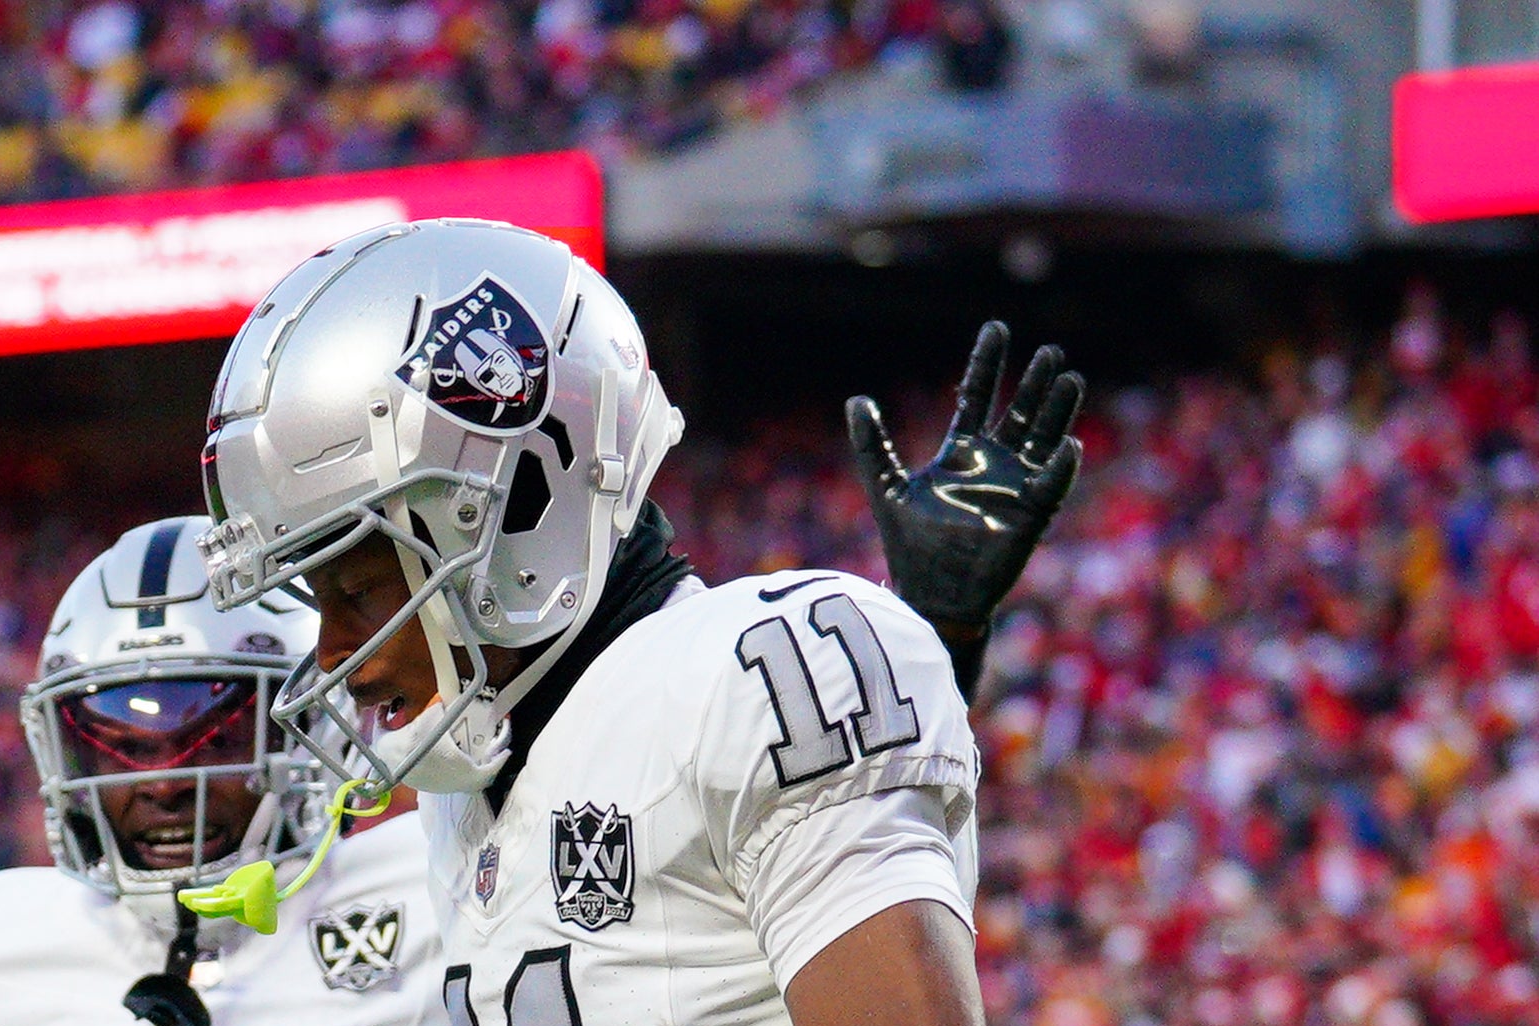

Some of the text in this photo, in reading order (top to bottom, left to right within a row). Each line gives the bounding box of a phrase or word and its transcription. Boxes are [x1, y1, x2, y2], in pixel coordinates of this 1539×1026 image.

[409, 287, 494, 378] RAIDERS
[734, 592, 921, 789] 11
[560, 841, 625, 880] LXV
[321, 920, 398, 960] LXV
